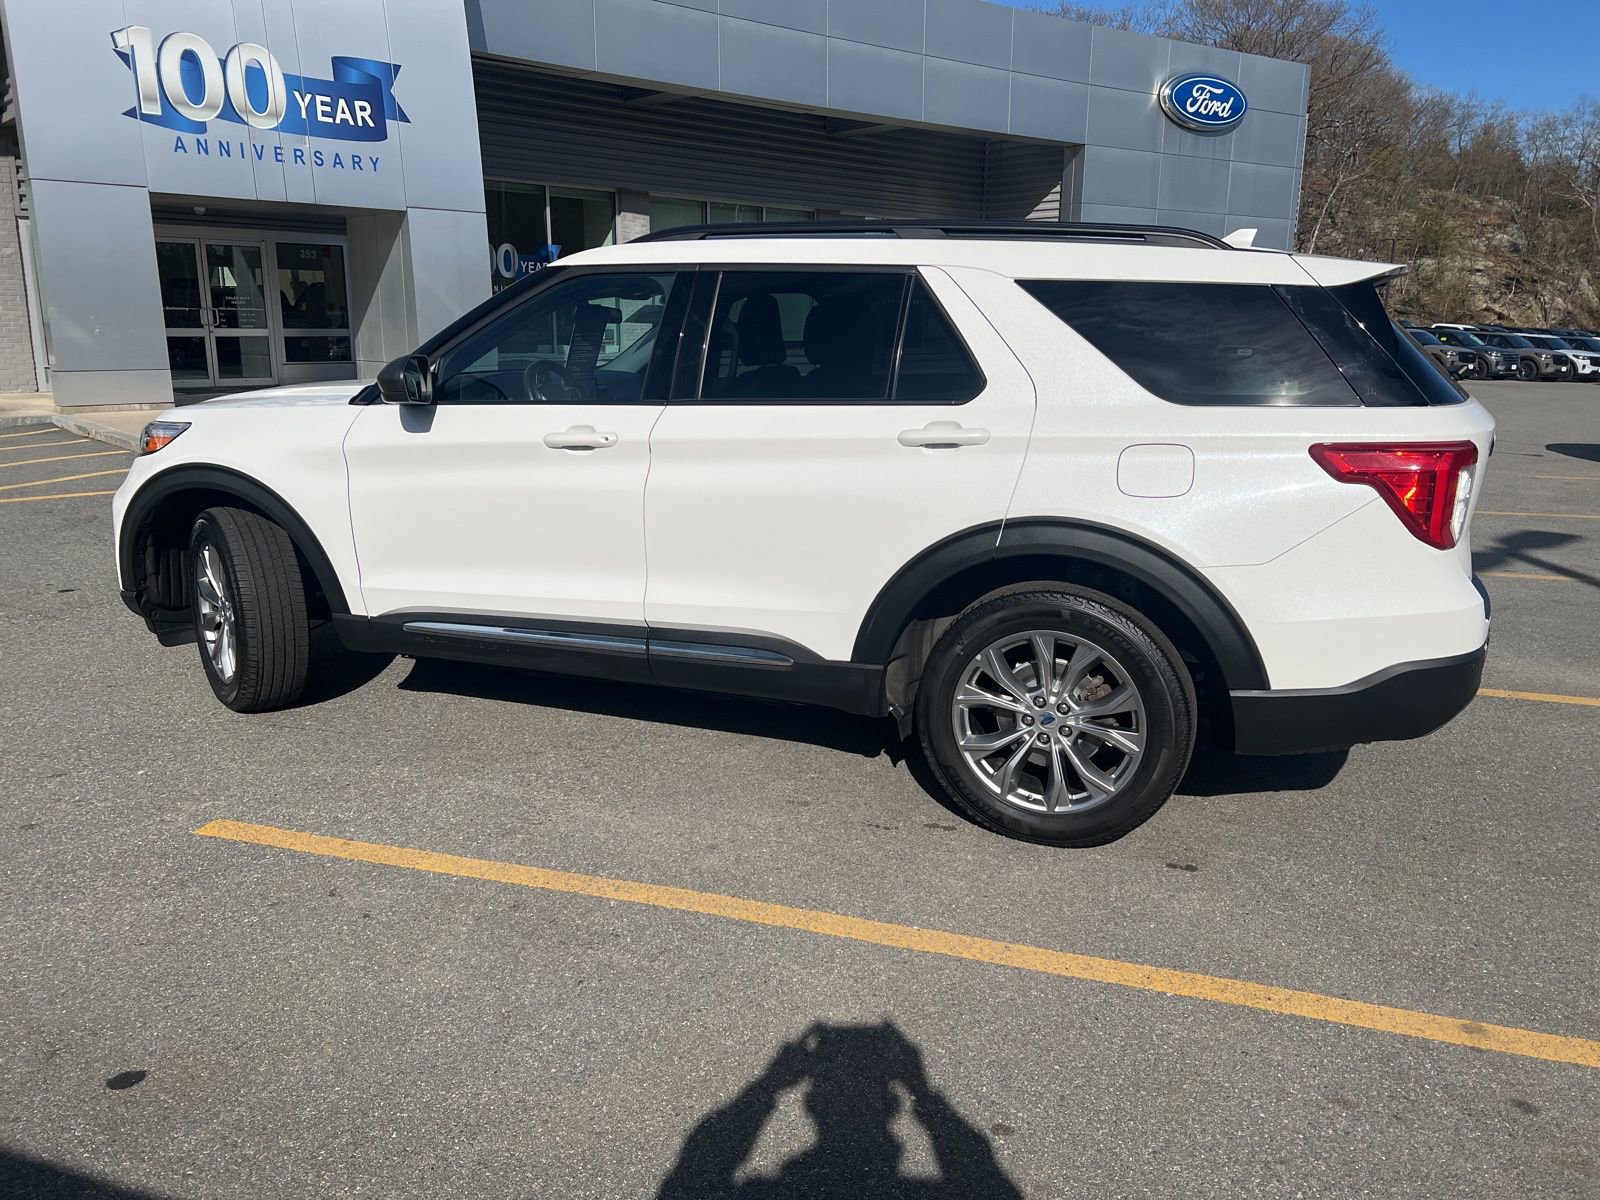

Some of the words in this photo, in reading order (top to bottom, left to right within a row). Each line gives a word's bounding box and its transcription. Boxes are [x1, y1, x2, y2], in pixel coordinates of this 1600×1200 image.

[110, 25, 287, 129] 100
[292, 90, 376, 128] YEAR
[1186, 83, 1235, 118] Ford
[173, 135, 380, 173] ANNIVERSARY
[299, 249, 318, 260] 353
